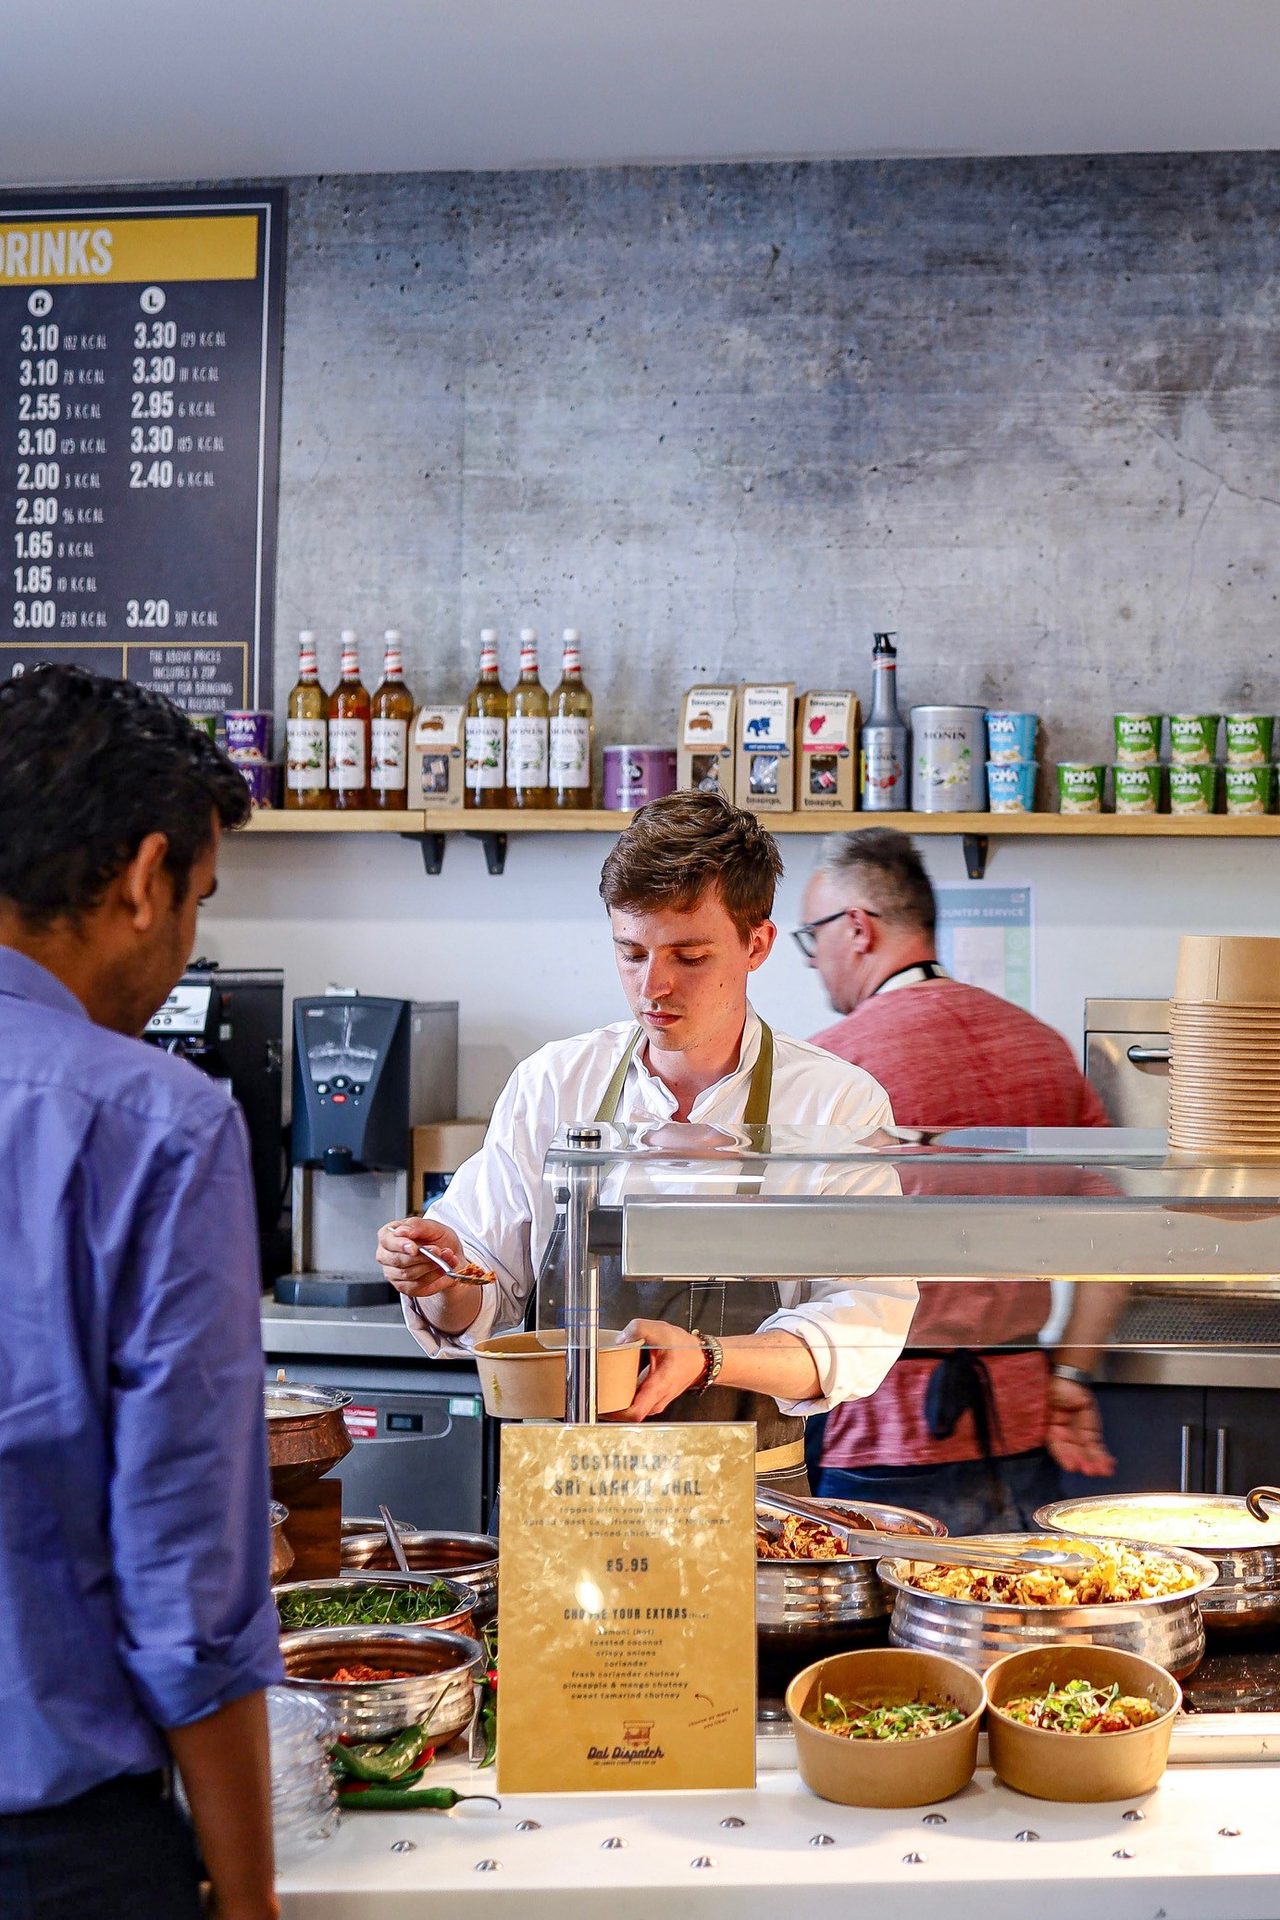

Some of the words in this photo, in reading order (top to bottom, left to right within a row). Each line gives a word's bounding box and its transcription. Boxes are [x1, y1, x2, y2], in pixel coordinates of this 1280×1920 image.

[0, 228, 113, 277] RINKS
[20, 324, 59, 352] 3.10
[80, 334, 107, 350] KCAL
[134, 321, 177, 349] 3.30
[199, 331, 226, 347] KCAL
[19, 358, 58, 386] 3.10
[78, 368, 105, 385] KCAL
[132, 355, 175, 384] 3.30
[192, 366, 219, 382] KCAL
[18, 393, 61, 421] 2.55
[74, 403, 101, 419] KCAL
[131, 390, 174, 418] 2.95
[188, 401, 216, 417] KCAL
[18, 427, 57, 455] 3.10
[79, 438, 107, 454] KCAL
[130, 425, 173, 453] 3.30
[197, 435, 224, 452] KCAL
[17, 462, 60, 490] 2.00
[74, 472, 101, 489] KCAL
[129, 460, 173, 488] 2.40
[188, 471, 215, 487] KCAL
[15, 497, 58, 525] 2.90
[77, 508, 104, 523] KCAL
[14, 531, 53, 558] 1.65
[68, 542, 95, 557] KCAL
[14, 566, 52, 593] 1.85
[70, 576, 97, 592] KCAL
[13, 600, 56, 628] 3.00
[80, 611, 107, 627] KCAL
[126, 600, 169, 627] 3.20
[191, 610, 218, 627] KCAL
[923, 731, 966, 740] MONIN
[1119, 720, 1153, 734] MOMA
[1171, 721, 1204, 734] MOMA
[1227, 721, 1259, 735] MOMA
[1063, 770, 1097, 784] MOMA
[1116, 770, 1150, 784] MOMA
[940, 909, 981, 918] OUNTER
[982, 908, 1024, 917] SERVICE
[570, 1454, 681, 1471] SUSTAINABE
[554, 1479, 581, 1496] SRI
[606, 1558, 649, 1572] £5.95
[564, 1608, 607, 1620] CHOSE
[613, 1608, 641, 1620] YOUR
[646, 1608, 688, 1620] EXTRAS
[627, 1639, 663, 1647] coconut
[562, 1681, 608, 1690] pineapple
[620, 1682, 650, 1690] mango
[653, 1681, 689, 1689] chutney
[644, 1671, 680, 1679] chutney
[601, 1691, 642, 1699] tamarind
[644, 1692, 680, 1700] chutney
[587, 1747, 609, 1760] Dal
[611, 1747, 665, 1762] Dispatch
